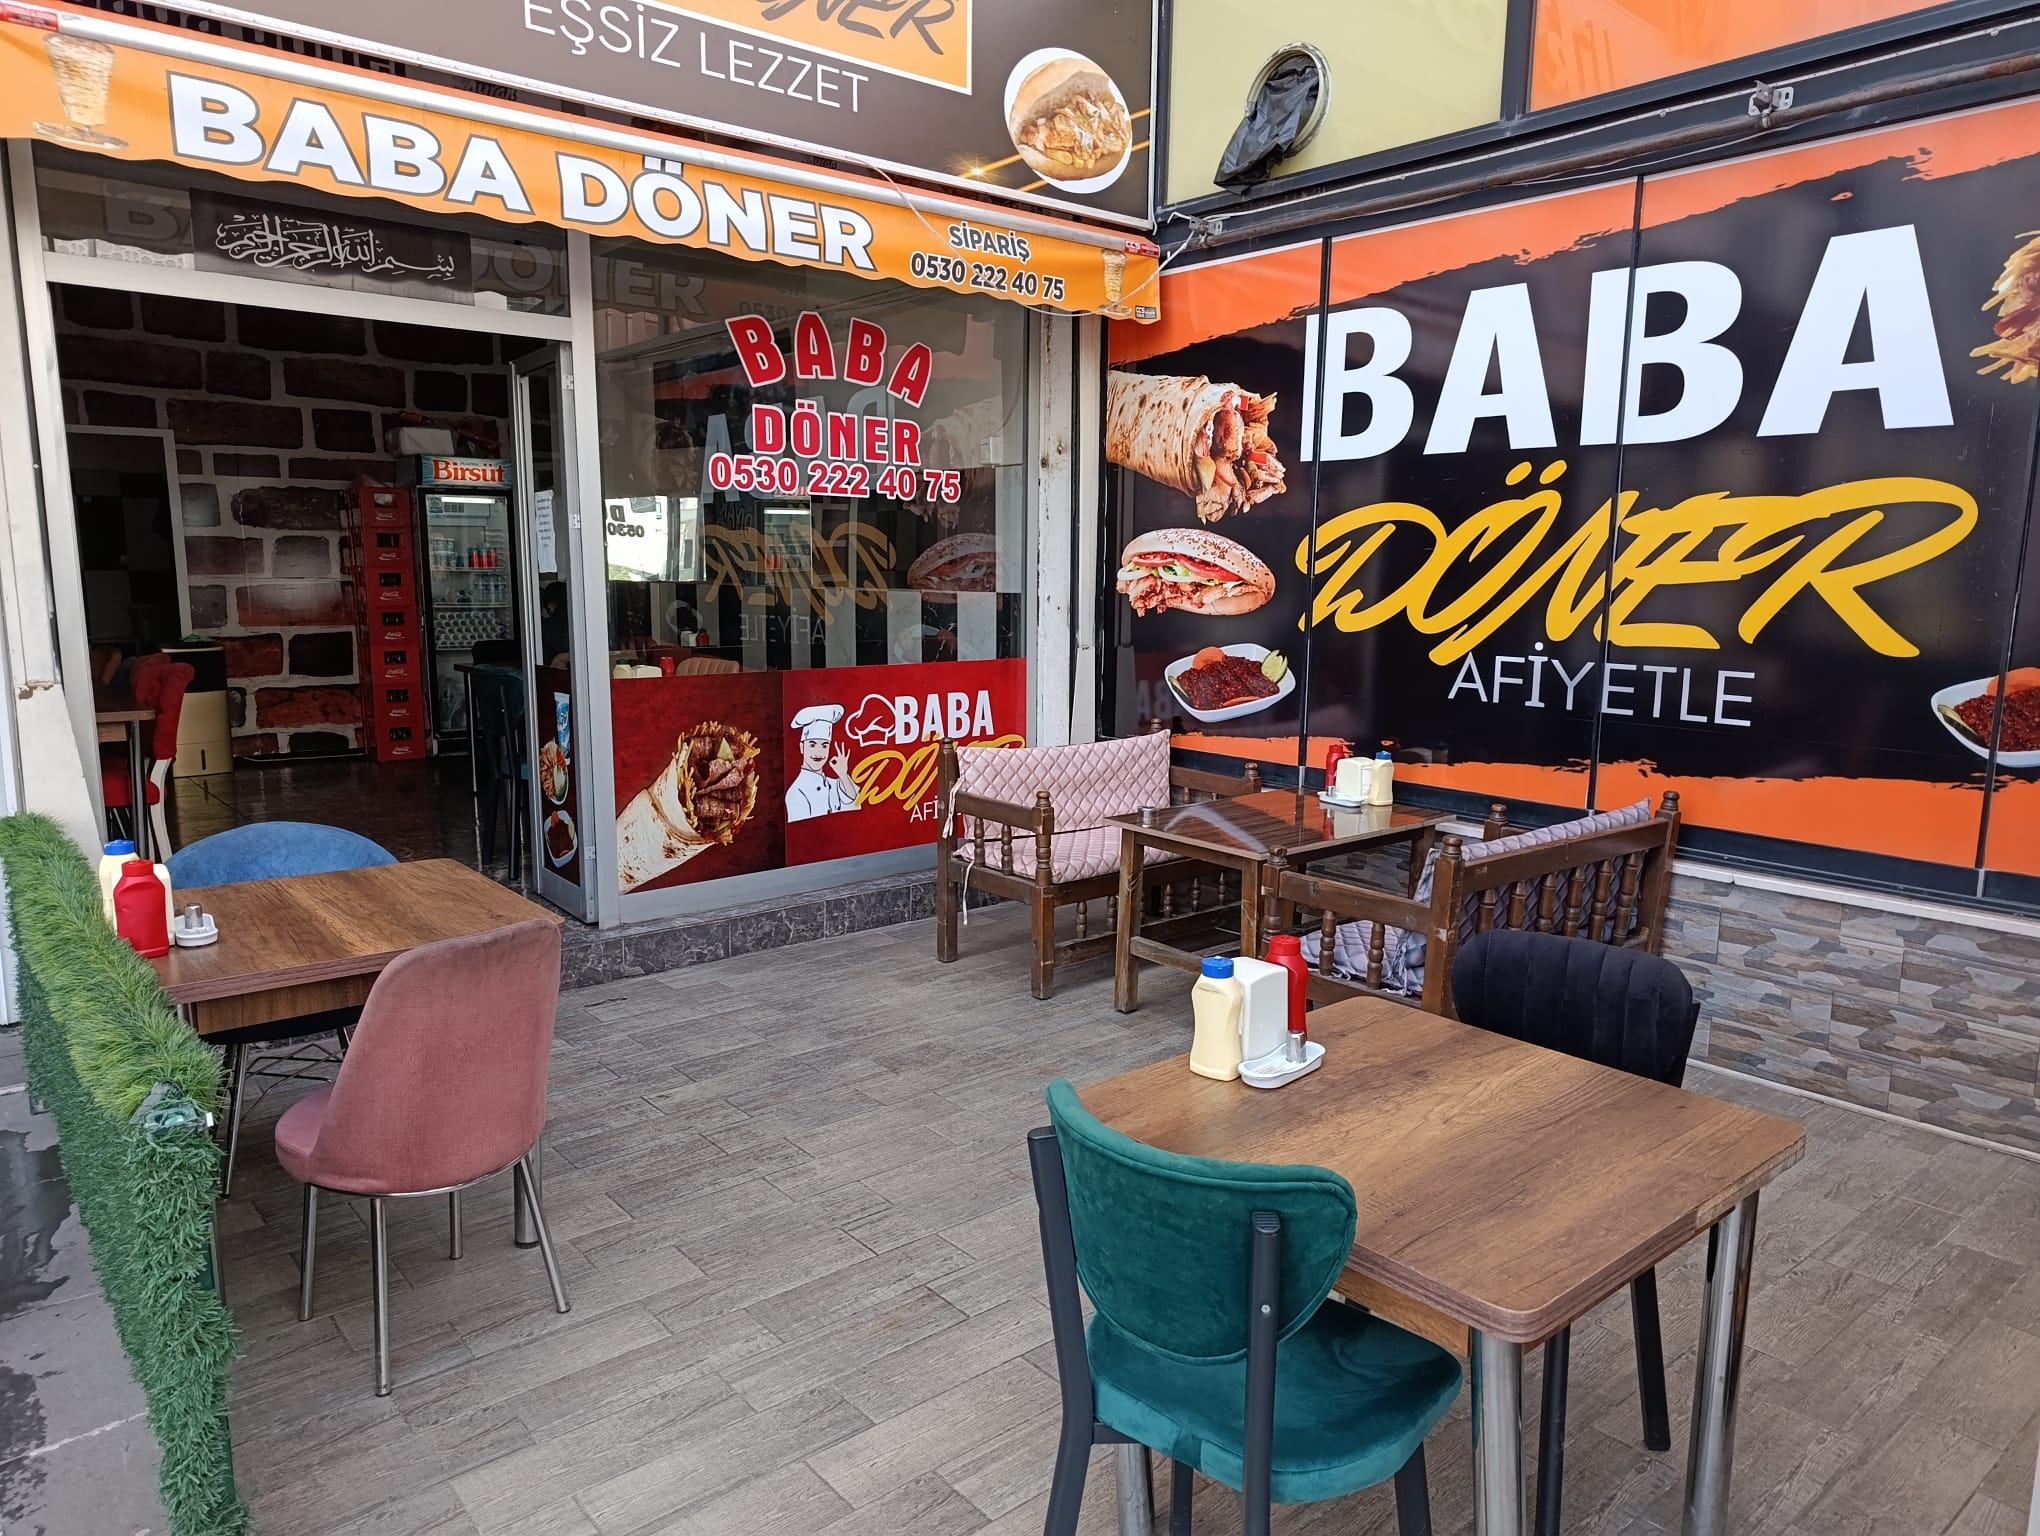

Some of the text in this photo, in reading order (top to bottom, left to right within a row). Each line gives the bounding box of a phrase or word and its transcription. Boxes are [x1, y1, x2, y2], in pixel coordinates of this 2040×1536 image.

[525, 0, 870, 113] EŞSİZ LEZZET
[166, 69, 880, 272] BABA DÖNER
[911, 252, 1064, 300] 0530 222 40 75
[949, 221, 1031, 262] SİPARİŞ
[725, 311, 932, 408] BABA
[1299, 224, 1956, 463] BABA
[432, 459, 505, 482] Birsüt
[752, 399, 921, 466] DÖNER
[709, 453, 961, 503] 0530 222 40 75
[1296, 460, 1980, 666] DÖNER
[894, 689, 994, 745] BABA
[1447, 641, 1755, 727] AFİYETLE
